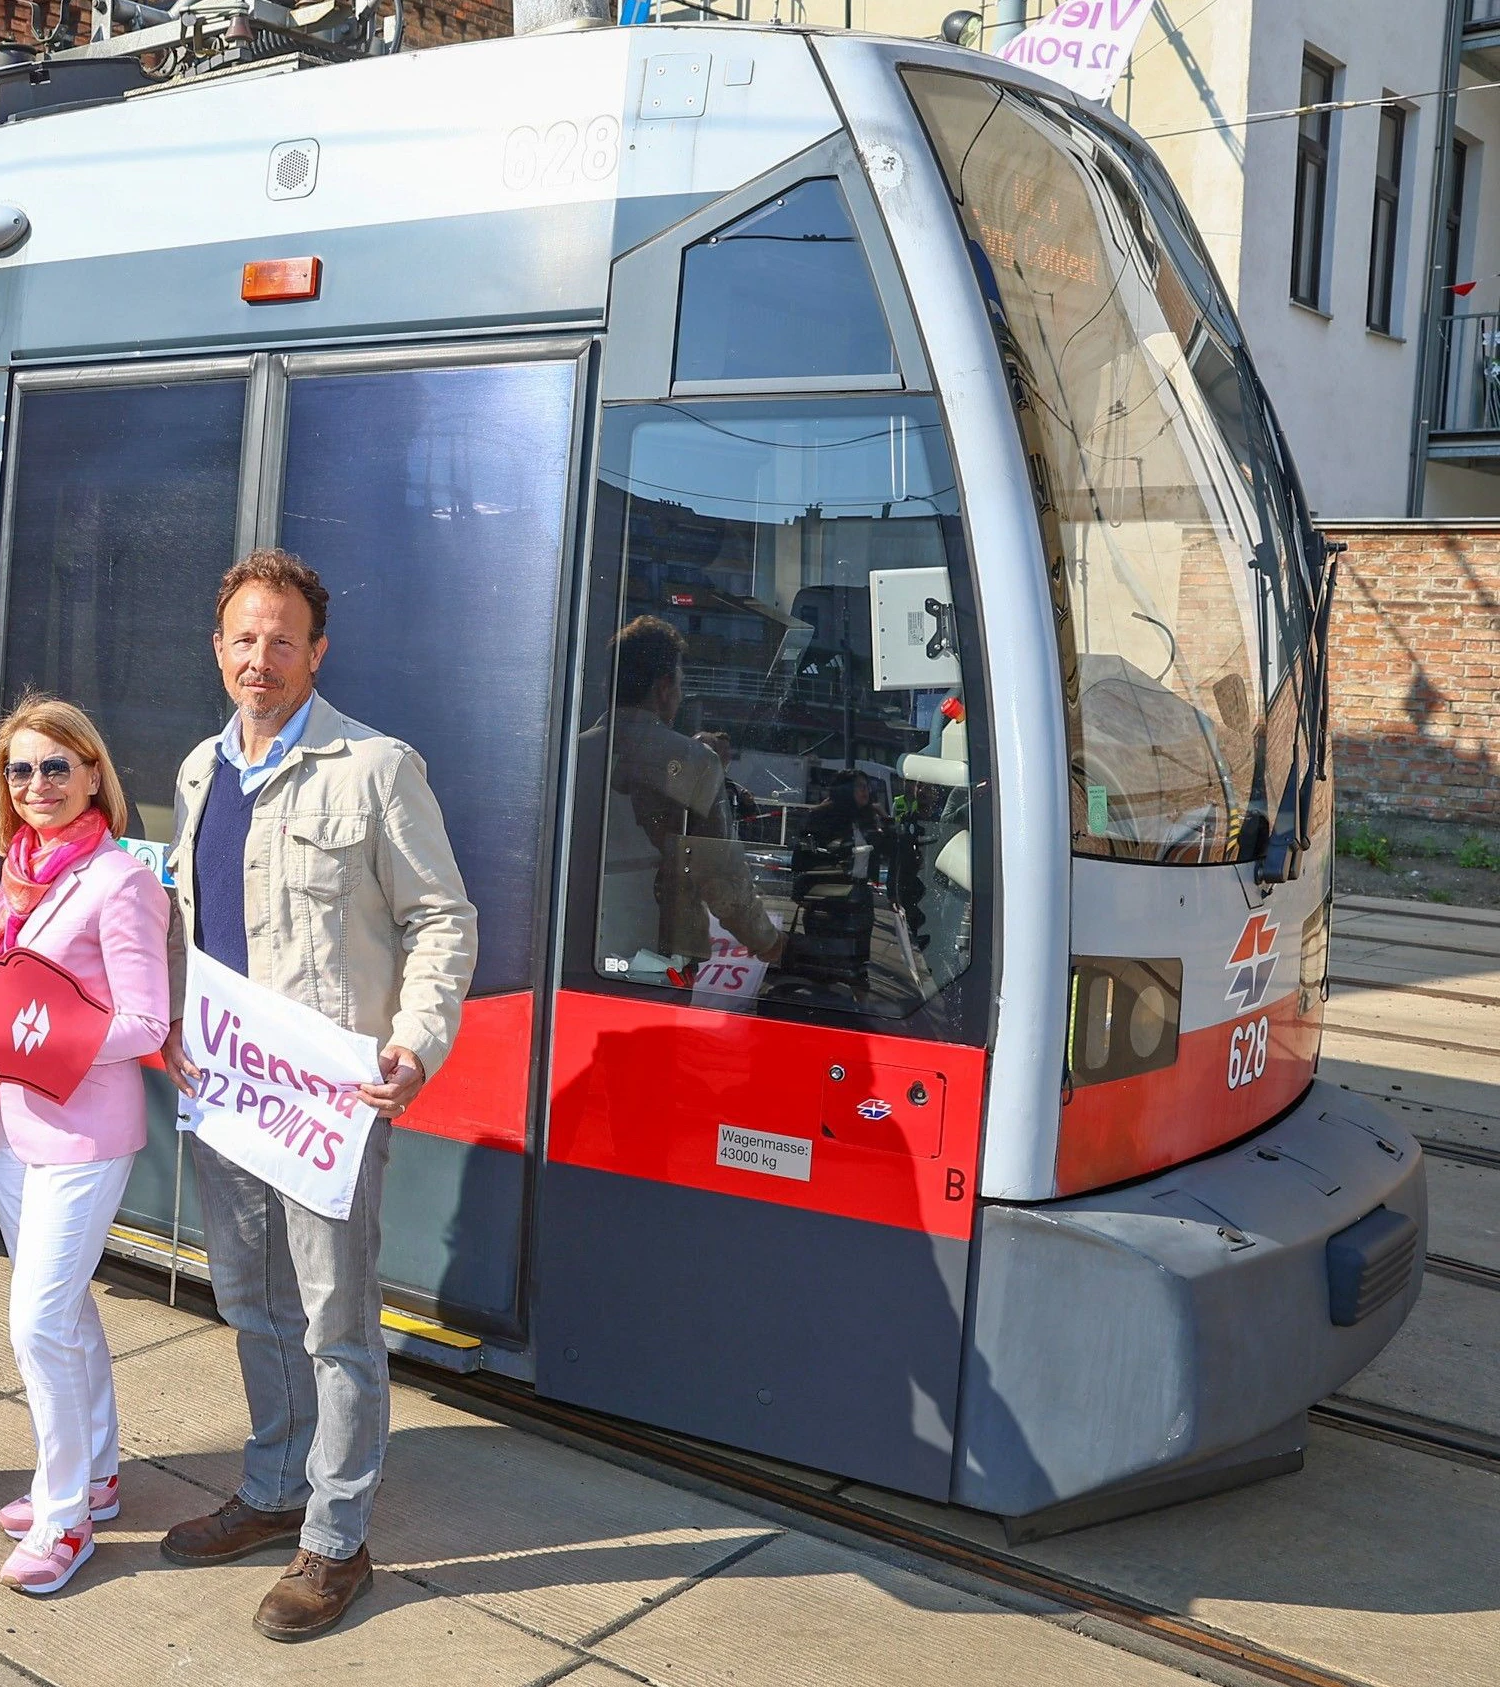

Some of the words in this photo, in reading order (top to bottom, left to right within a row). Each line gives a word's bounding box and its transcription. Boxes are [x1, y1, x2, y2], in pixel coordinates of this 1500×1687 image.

[503, 114, 619, 190] 628
[201, 996, 361, 1119] Vienna
[1227, 1015, 1268, 1091] 628
[198, 1068, 230, 1107] 12
[236, 1083, 344, 1171] POINTS
[721, 1129, 809, 1156] Wagenmasse:
[720, 1147, 759, 1164] 43000
[761, 1153, 778, 1170] kg
[945, 1167, 966, 1201] B
